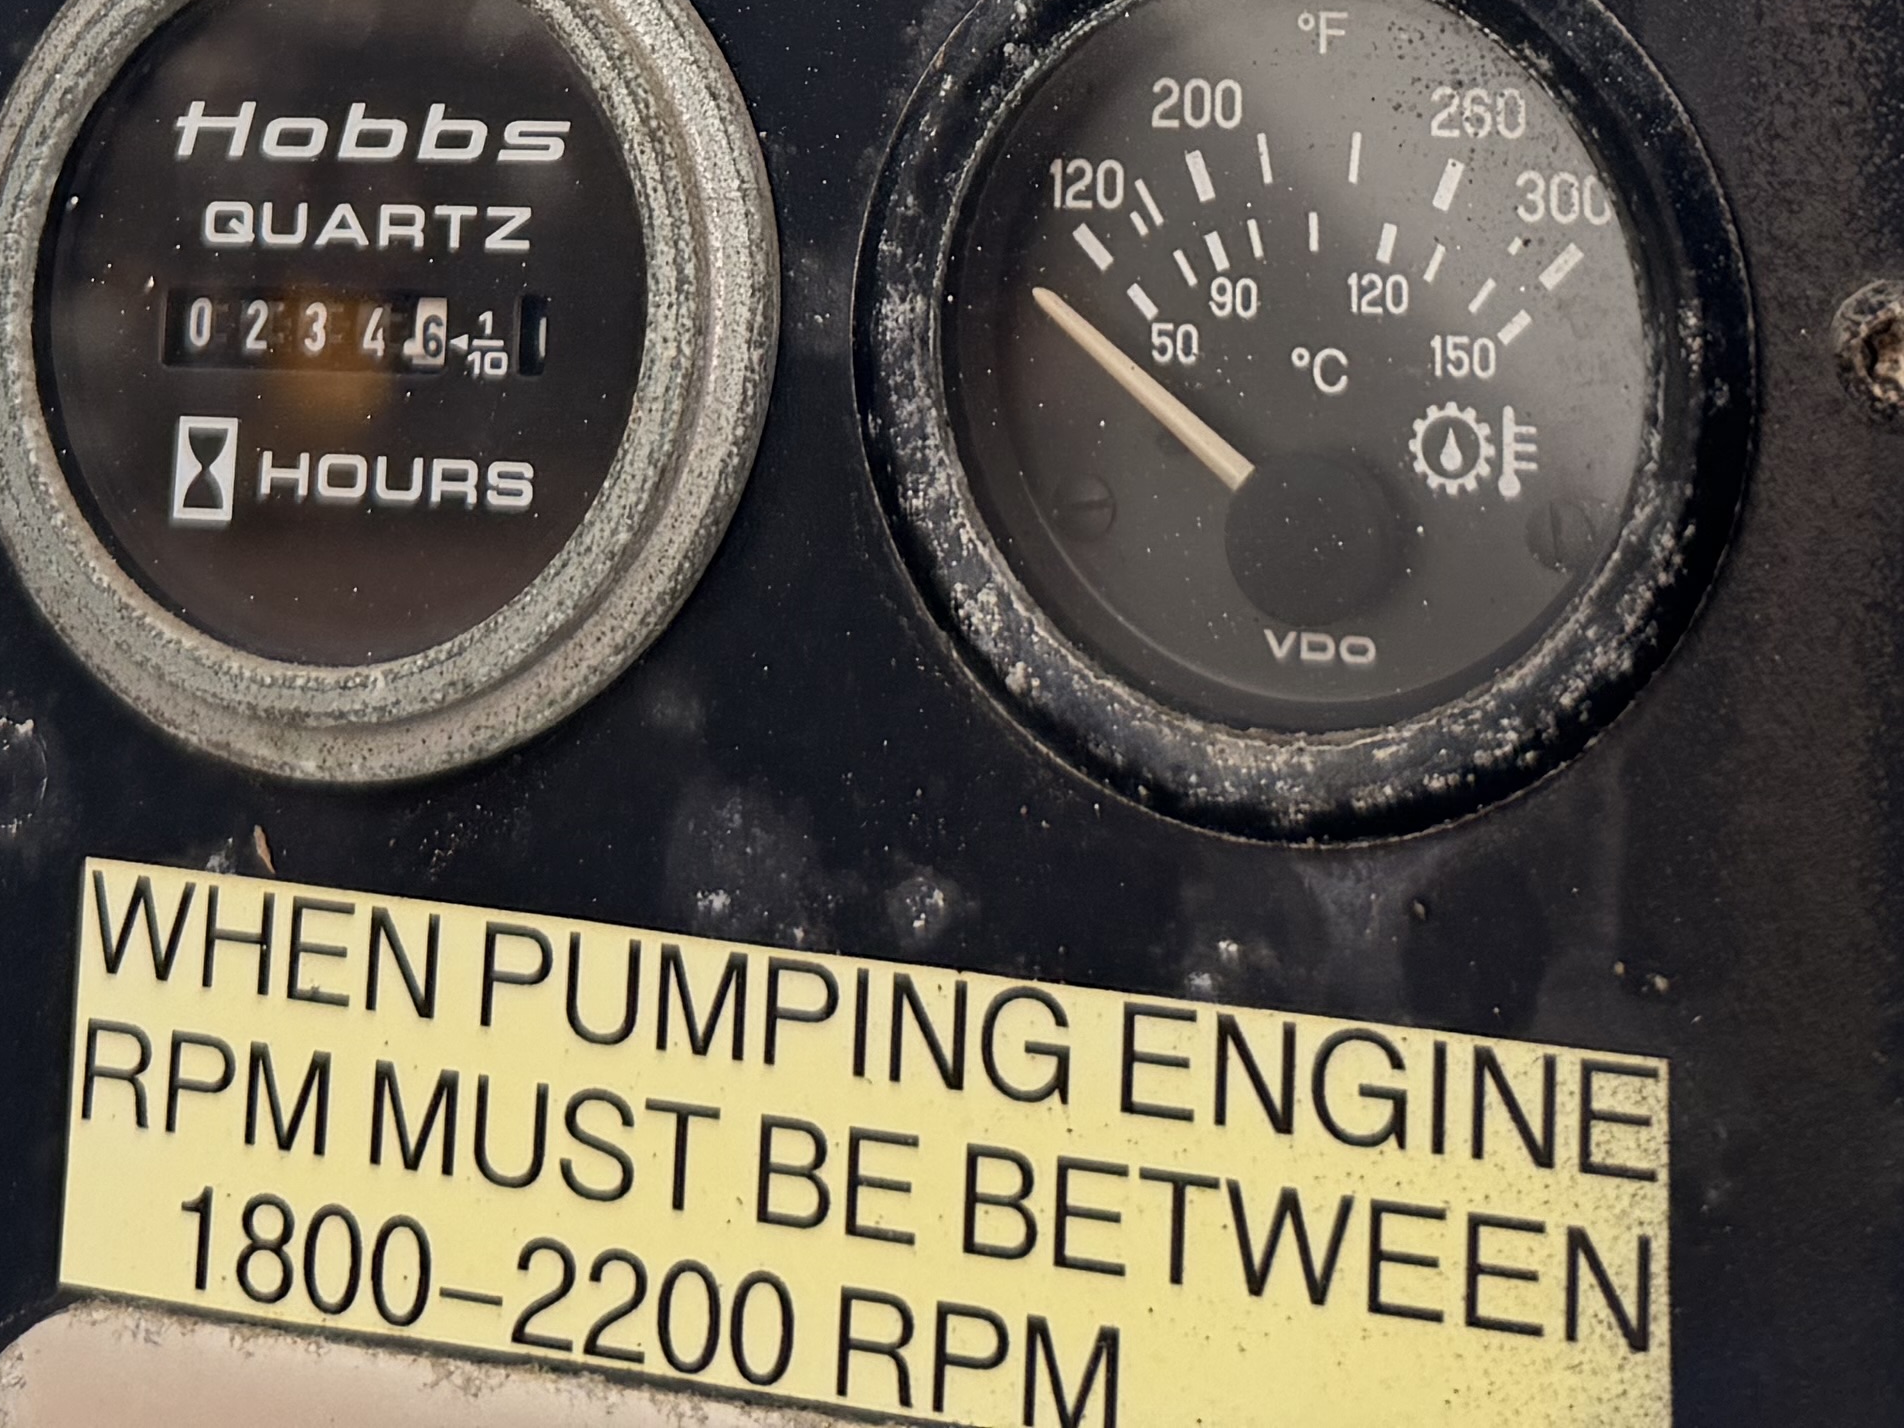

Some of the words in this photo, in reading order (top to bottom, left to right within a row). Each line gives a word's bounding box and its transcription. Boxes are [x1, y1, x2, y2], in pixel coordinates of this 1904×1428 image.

[1151, 78, 1243, 130] 200
[1430, 87, 1527, 140] 260
[175, 100, 571, 162] Hobbs
[1049, 158, 1124, 211] 120
[1516, 171, 1613, 227] 300
[204, 200, 532, 250] QUARTZ
[1210, 277, 1257, 318] 90
[1348, 273, 1408, 315] 120
[1152, 323, 1198, 366] 50
[1431, 337, 1495, 380] 150
[258, 450, 534, 507] HOURS
[1264, 630, 1377, 665] VDO
[92, 869, 441, 1020] WHEN
[479, 920, 1070, 1105] PUMPING
[1120, 1001, 1660, 1183] ENGINE
[80, 1017, 332, 1157] RPM
[368, 1058, 722, 1212] MUST
[755, 1111, 920, 1246] BE
[962, 1142, 1652, 1353] BETWEEN
[835, 1283, 1121, 1428] RPM
